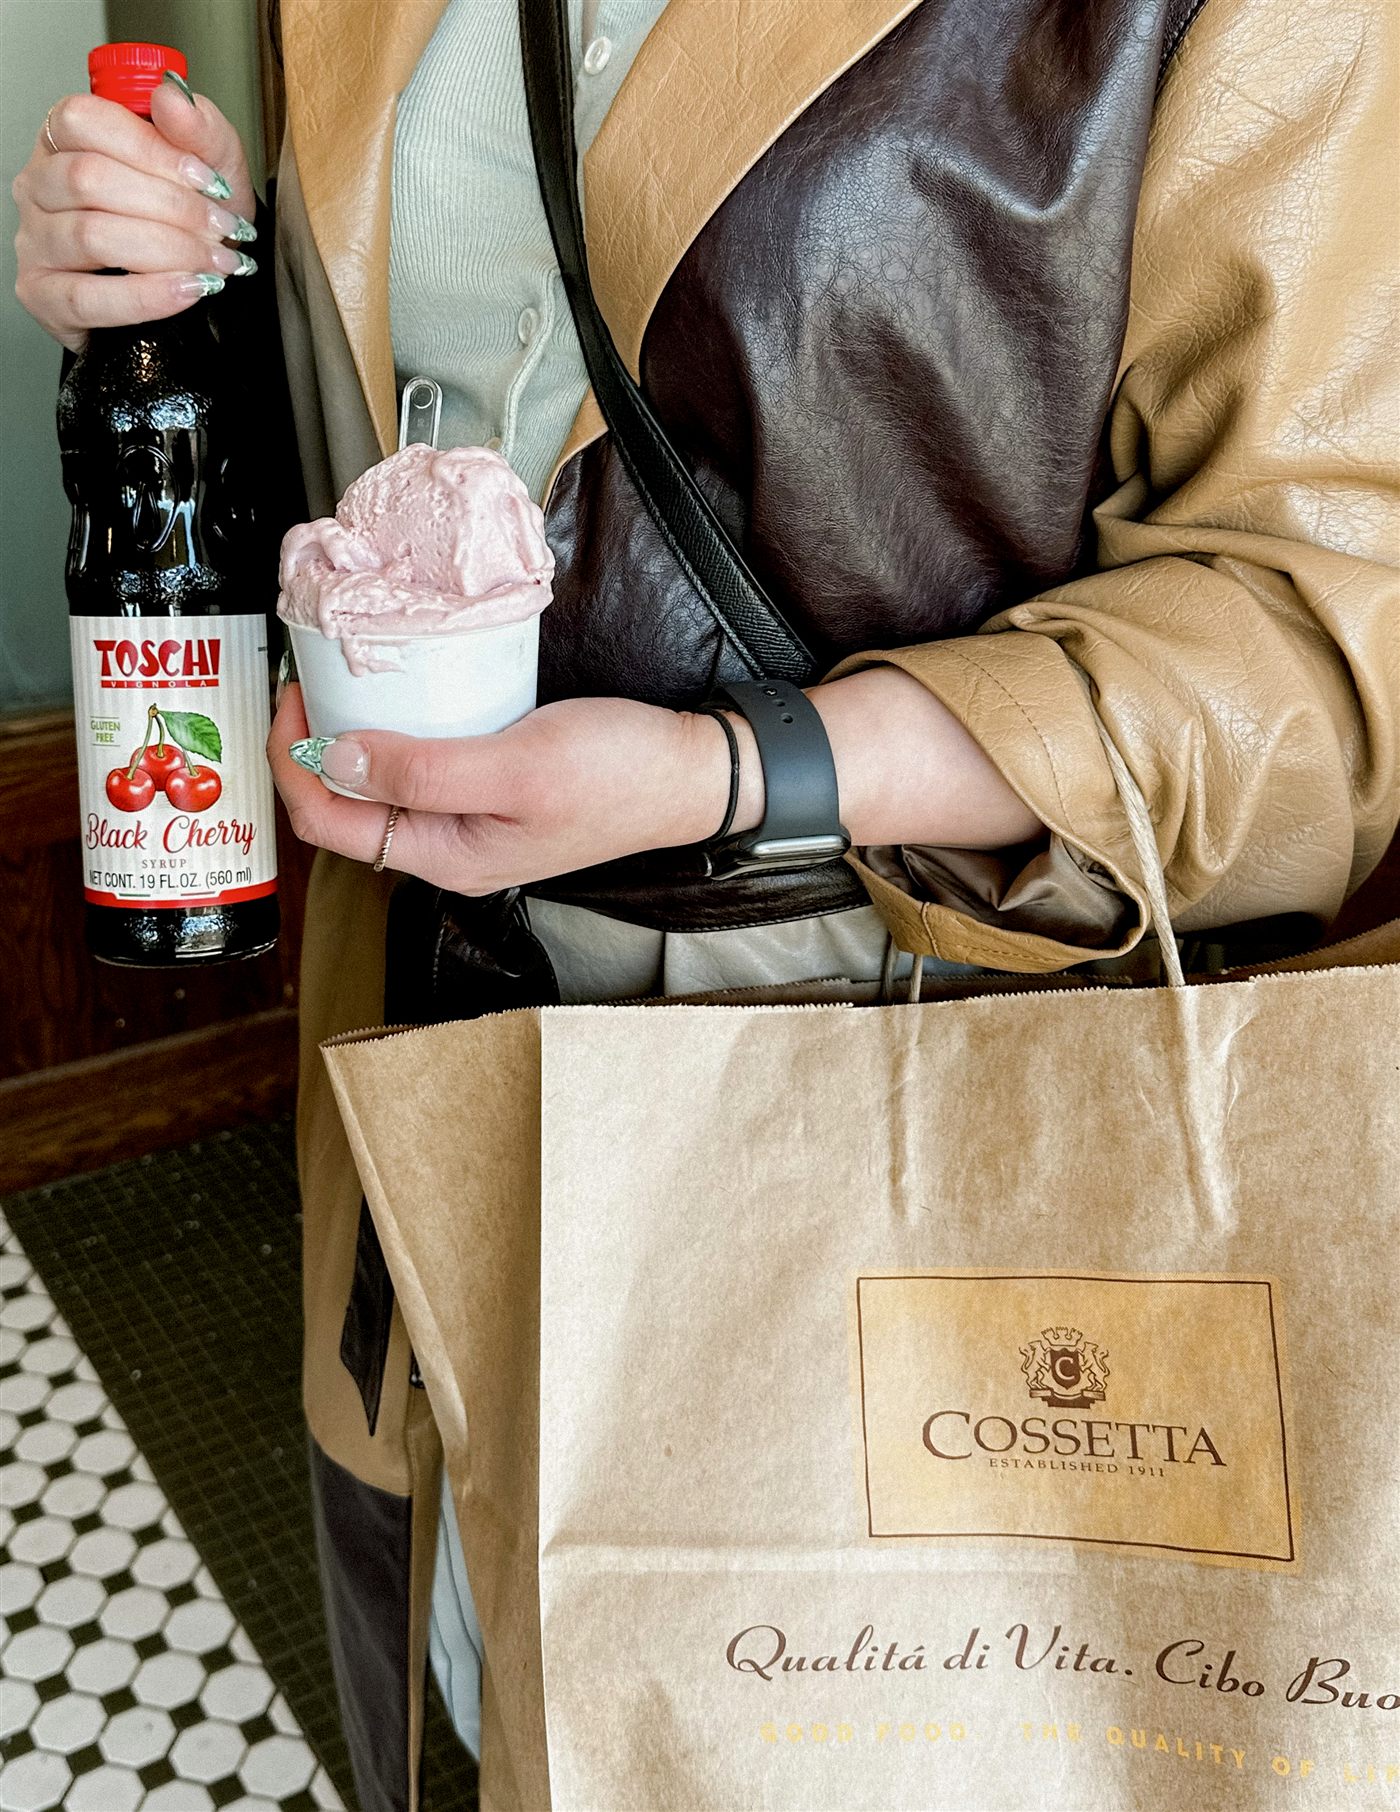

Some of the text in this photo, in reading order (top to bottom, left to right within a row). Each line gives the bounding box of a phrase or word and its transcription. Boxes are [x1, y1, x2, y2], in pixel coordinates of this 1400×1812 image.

[93, 639, 220, 677] TOSCHI
[111, 680, 207, 688] VIGNOLA
[91, 720, 120, 731] GLUTEN
[96, 733, 114, 743] FREE
[86, 812, 257, 855] Black Cherry
[142, 859, 187, 869] SYRUP
[90, 871, 102, 885] NET
[105, 872, 136, 889] CONT.
[140, 874, 155, 889] 19
[206, 869, 233, 888] (560
[236, 866, 252, 882] ml)
[1054, 1356, 1075, 1382] C
[989, 1458, 1165, 1478] ESTABLISHED 1911
[726, 1624, 927, 1682] Qualitá
[943, 1627, 990, 1671] di
[1005, 1623, 1133, 1676] Vita.
[1155, 1639, 1265, 1697] Cibo
[759, 1721, 853, 1744] GOOD
[1020, 1722, 1083, 1741] THE
[1106, 1726, 1247, 1769] QUALITY
[1271, 1755, 1316, 1777] OF
